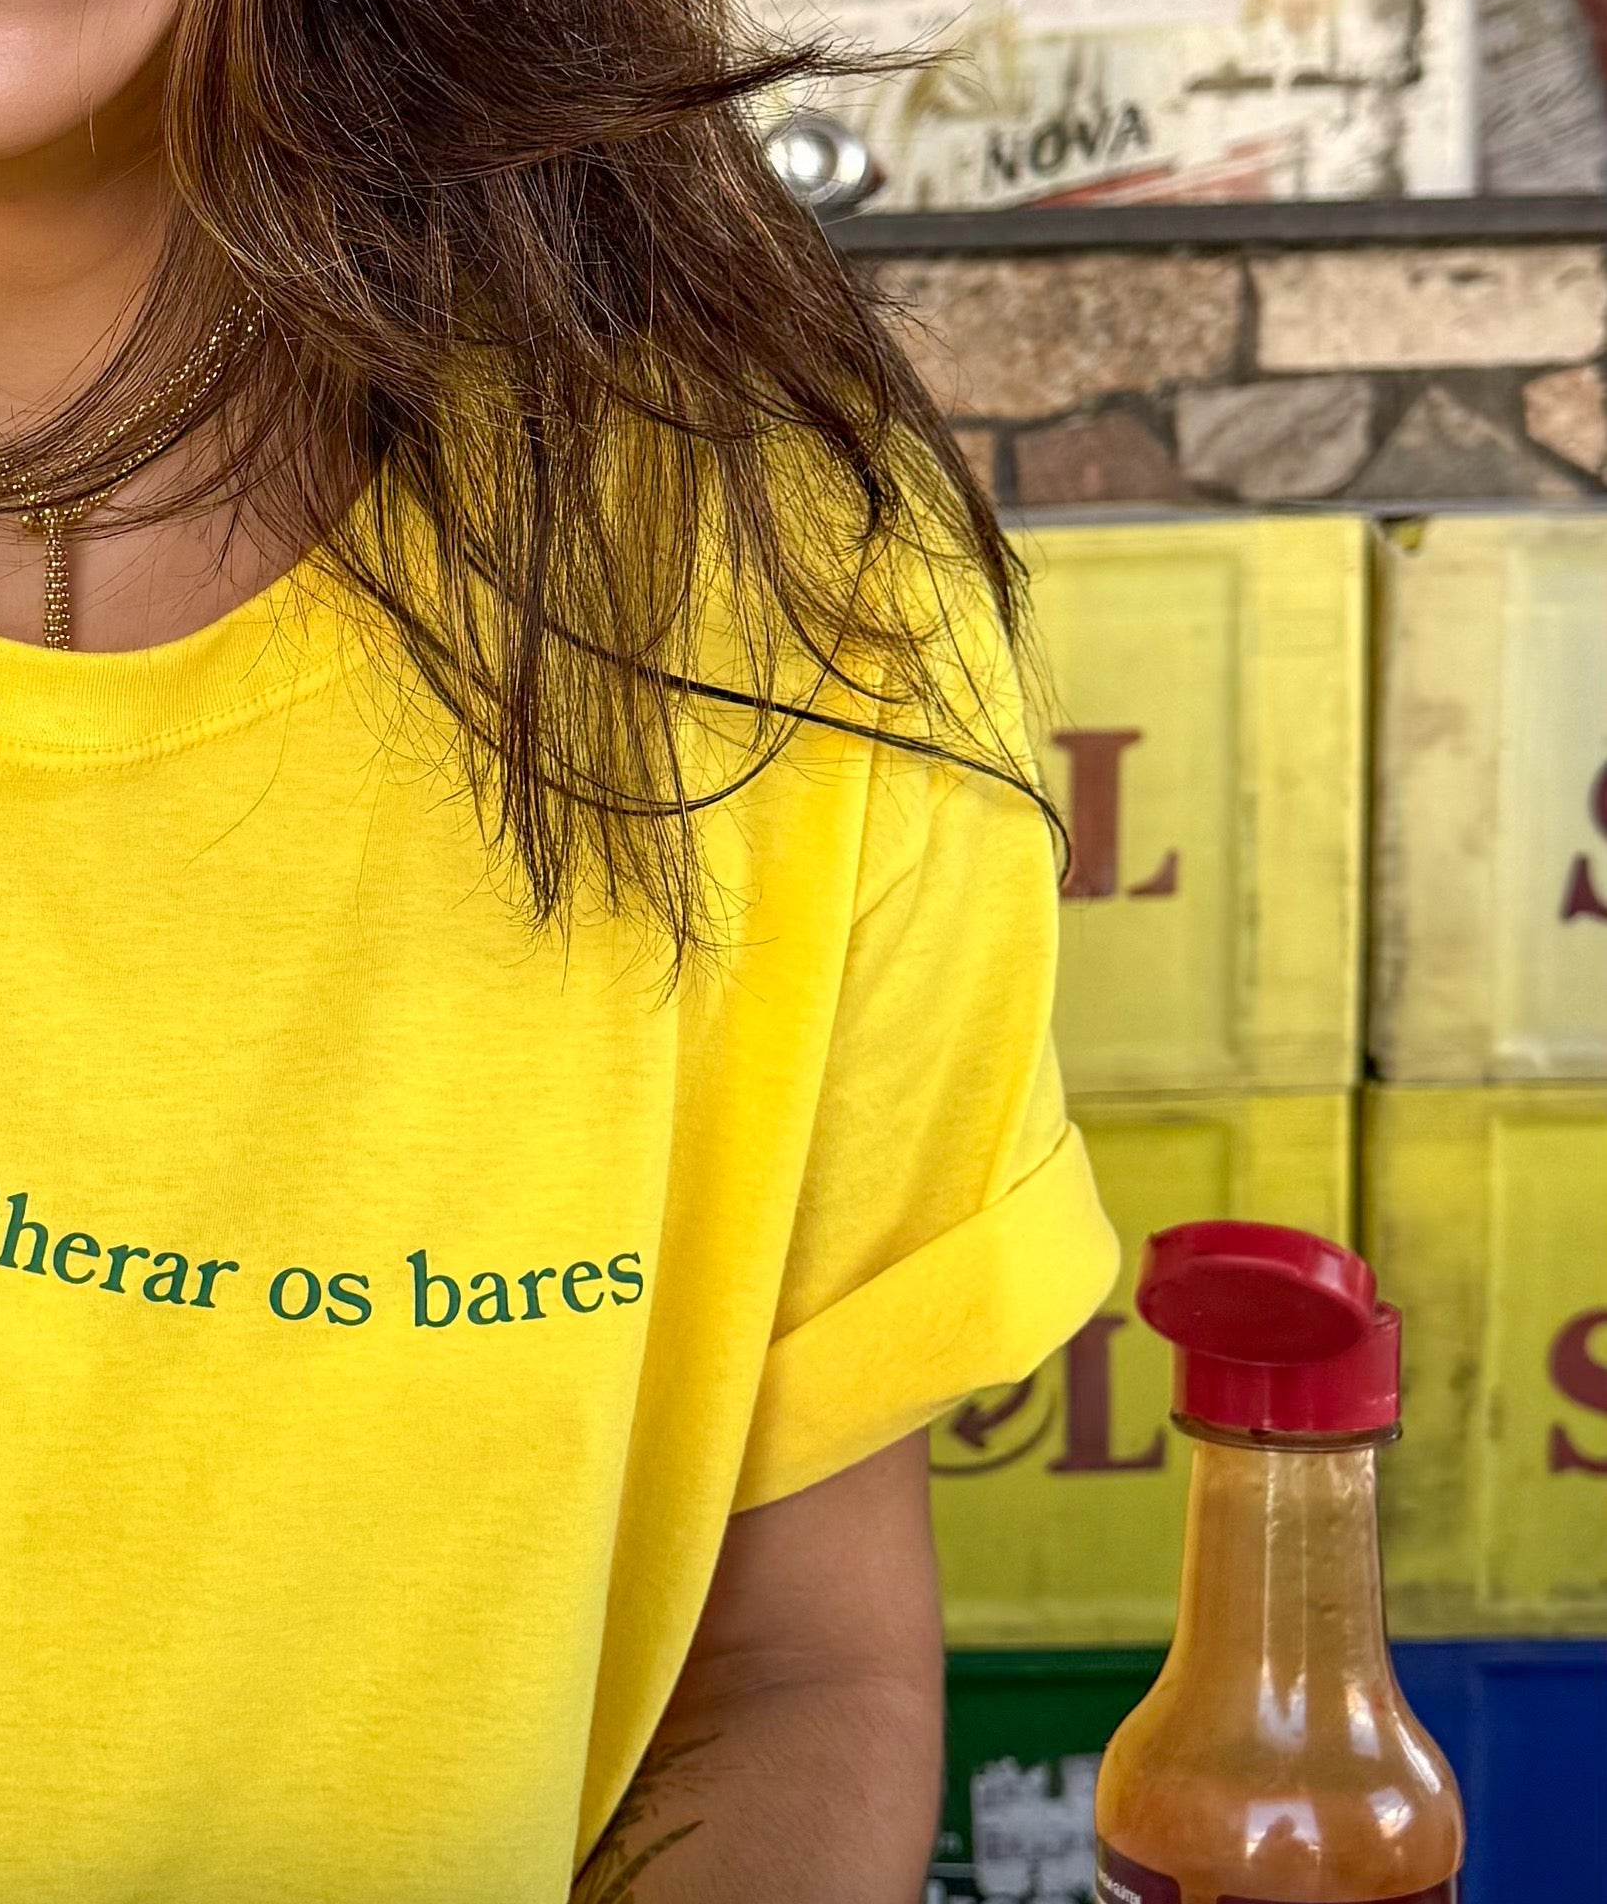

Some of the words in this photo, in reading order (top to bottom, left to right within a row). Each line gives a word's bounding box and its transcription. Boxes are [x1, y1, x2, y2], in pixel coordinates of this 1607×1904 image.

[981, 99, 1153, 192] NOVA
[270, 1266, 372, 1326] os
[409, 1249, 643, 1329] bares
